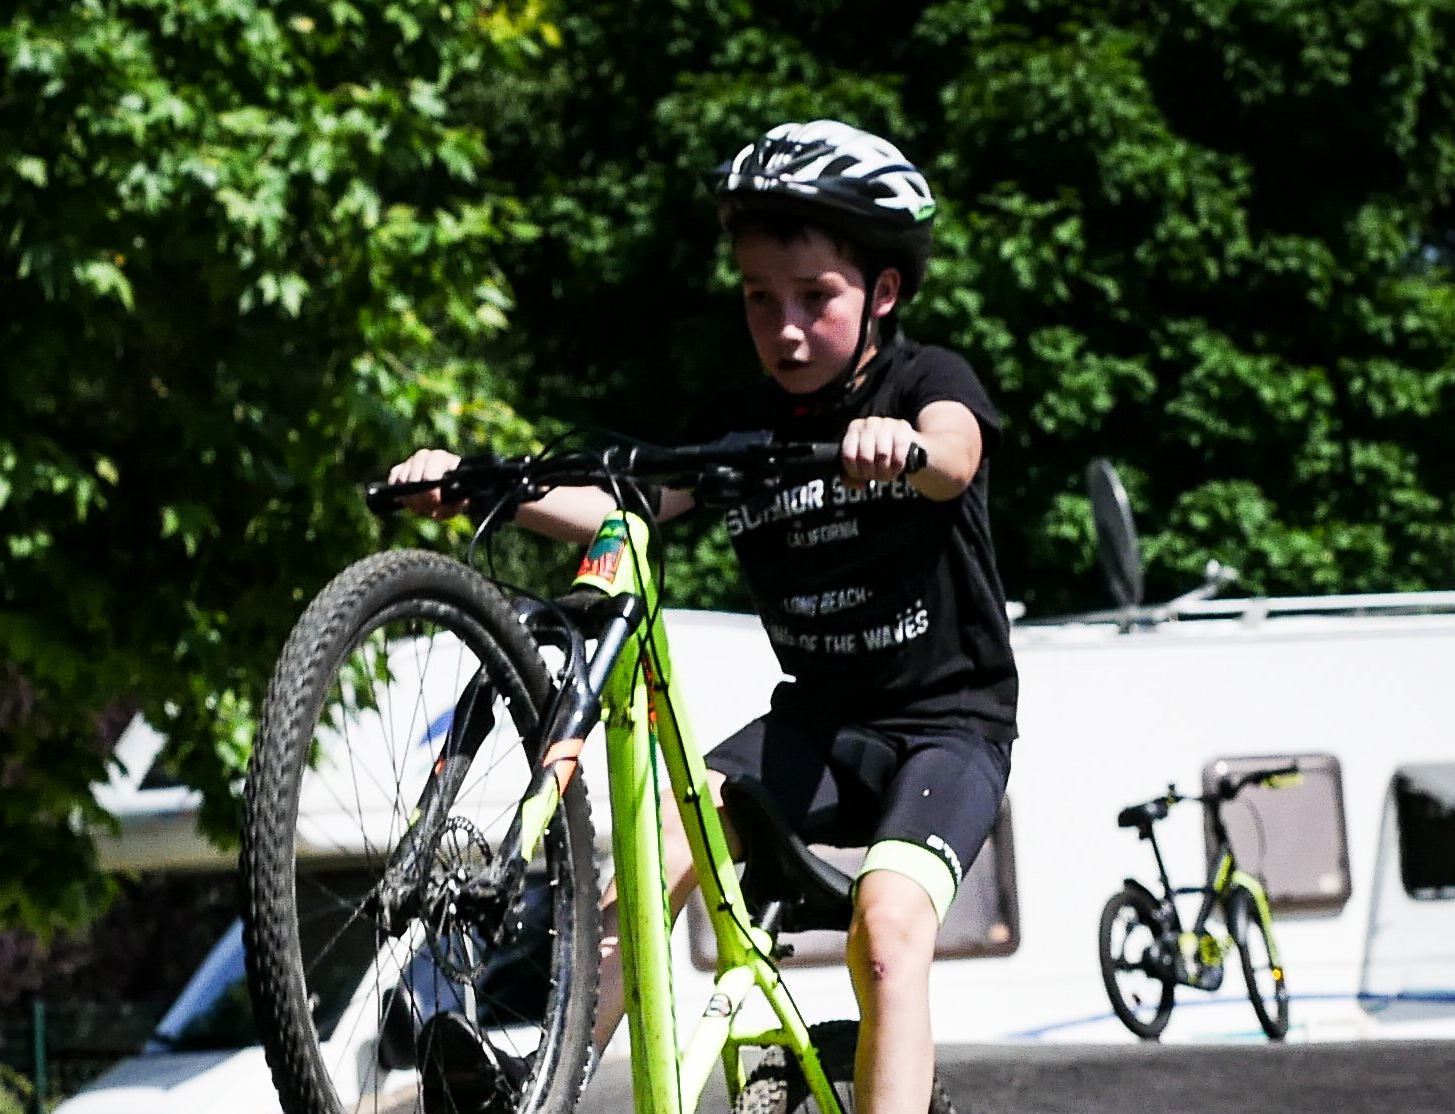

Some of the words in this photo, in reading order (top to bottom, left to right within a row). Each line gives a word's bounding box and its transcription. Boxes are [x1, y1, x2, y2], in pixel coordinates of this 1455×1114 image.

[787, 519, 860, 547] CALIFORNIA
[798, 634, 819, 651] OF
[823, 633, 857, 653] THE
[862, 608, 930, 651] WAVES
